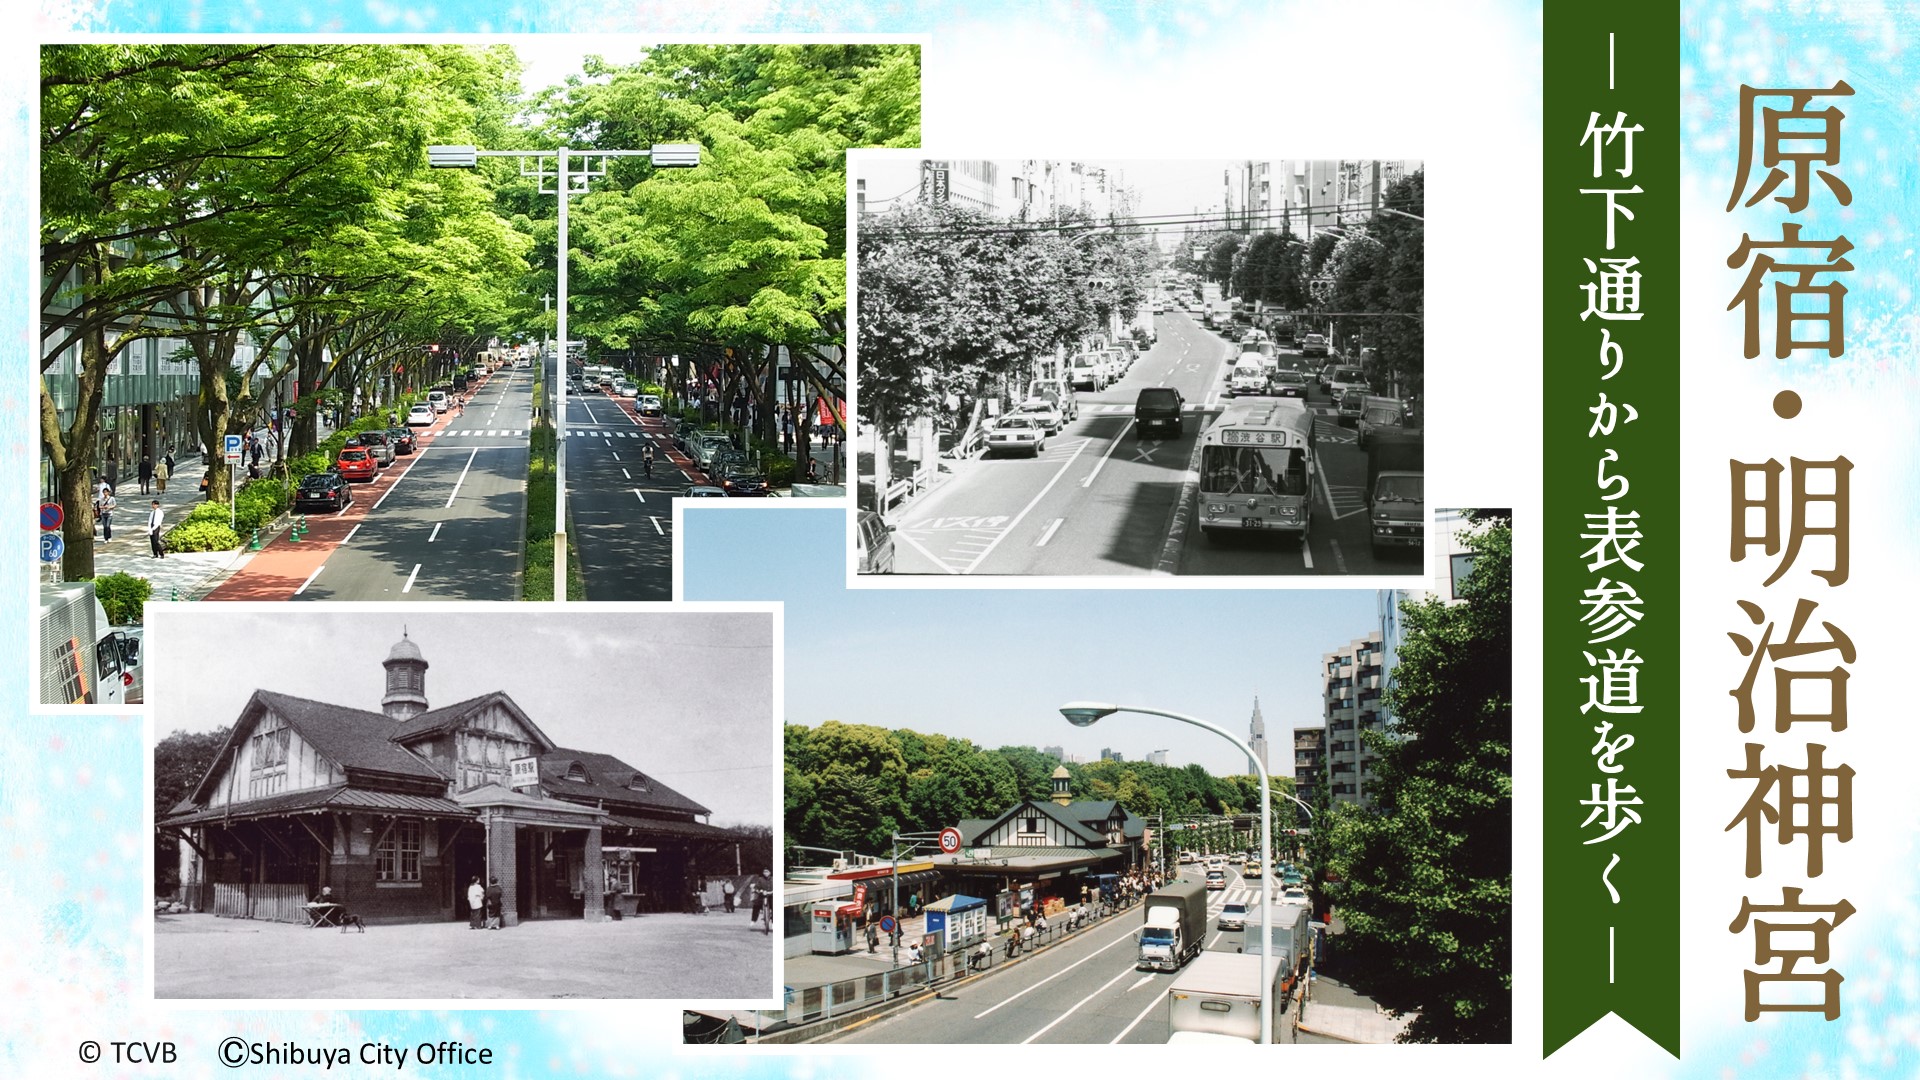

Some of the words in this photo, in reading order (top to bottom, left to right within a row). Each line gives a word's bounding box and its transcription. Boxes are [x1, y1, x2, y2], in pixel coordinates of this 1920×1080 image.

[1240, 431, 1281, 443] 渋谷駅
[226, 437, 240, 452] P
[943, 835, 957, 848] 50
